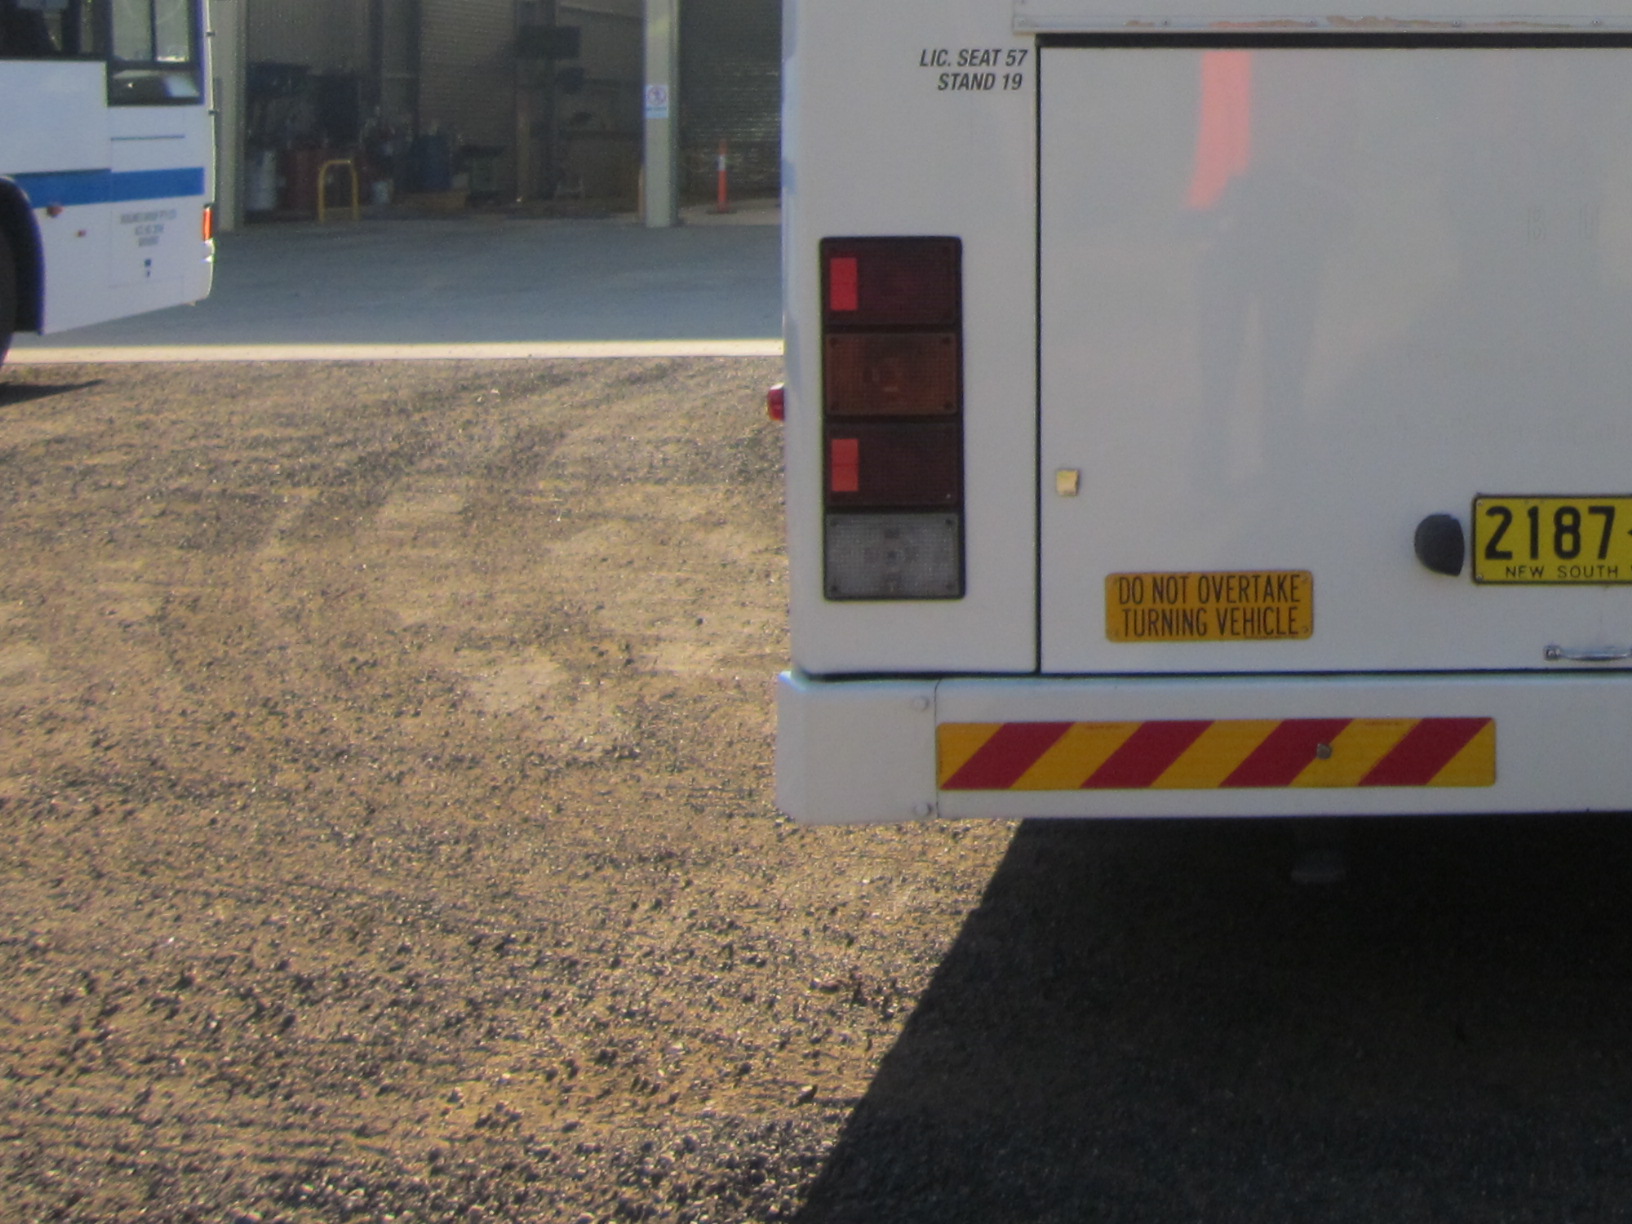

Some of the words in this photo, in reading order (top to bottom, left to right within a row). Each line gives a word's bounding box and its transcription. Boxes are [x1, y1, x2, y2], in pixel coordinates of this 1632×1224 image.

[919, 48, 952, 67] LIC.
[957, 48, 1002, 67] SEAT
[1005, 48, 1029, 67] 57
[937, 72, 996, 91] STAND
[1002, 72, 1023, 91] 19
[1505, 565, 1545, 578] NEW
[1556, 565, 1619, 578] SOUTH
[1118, 576, 1145, 605] DO
[1152, 575, 1191, 605] NOT
[1197, 574, 1301, 605] OVERTAKE
[1121, 608, 1208, 638] TURNING
[1215, 606, 1299, 636] VEHICLE
